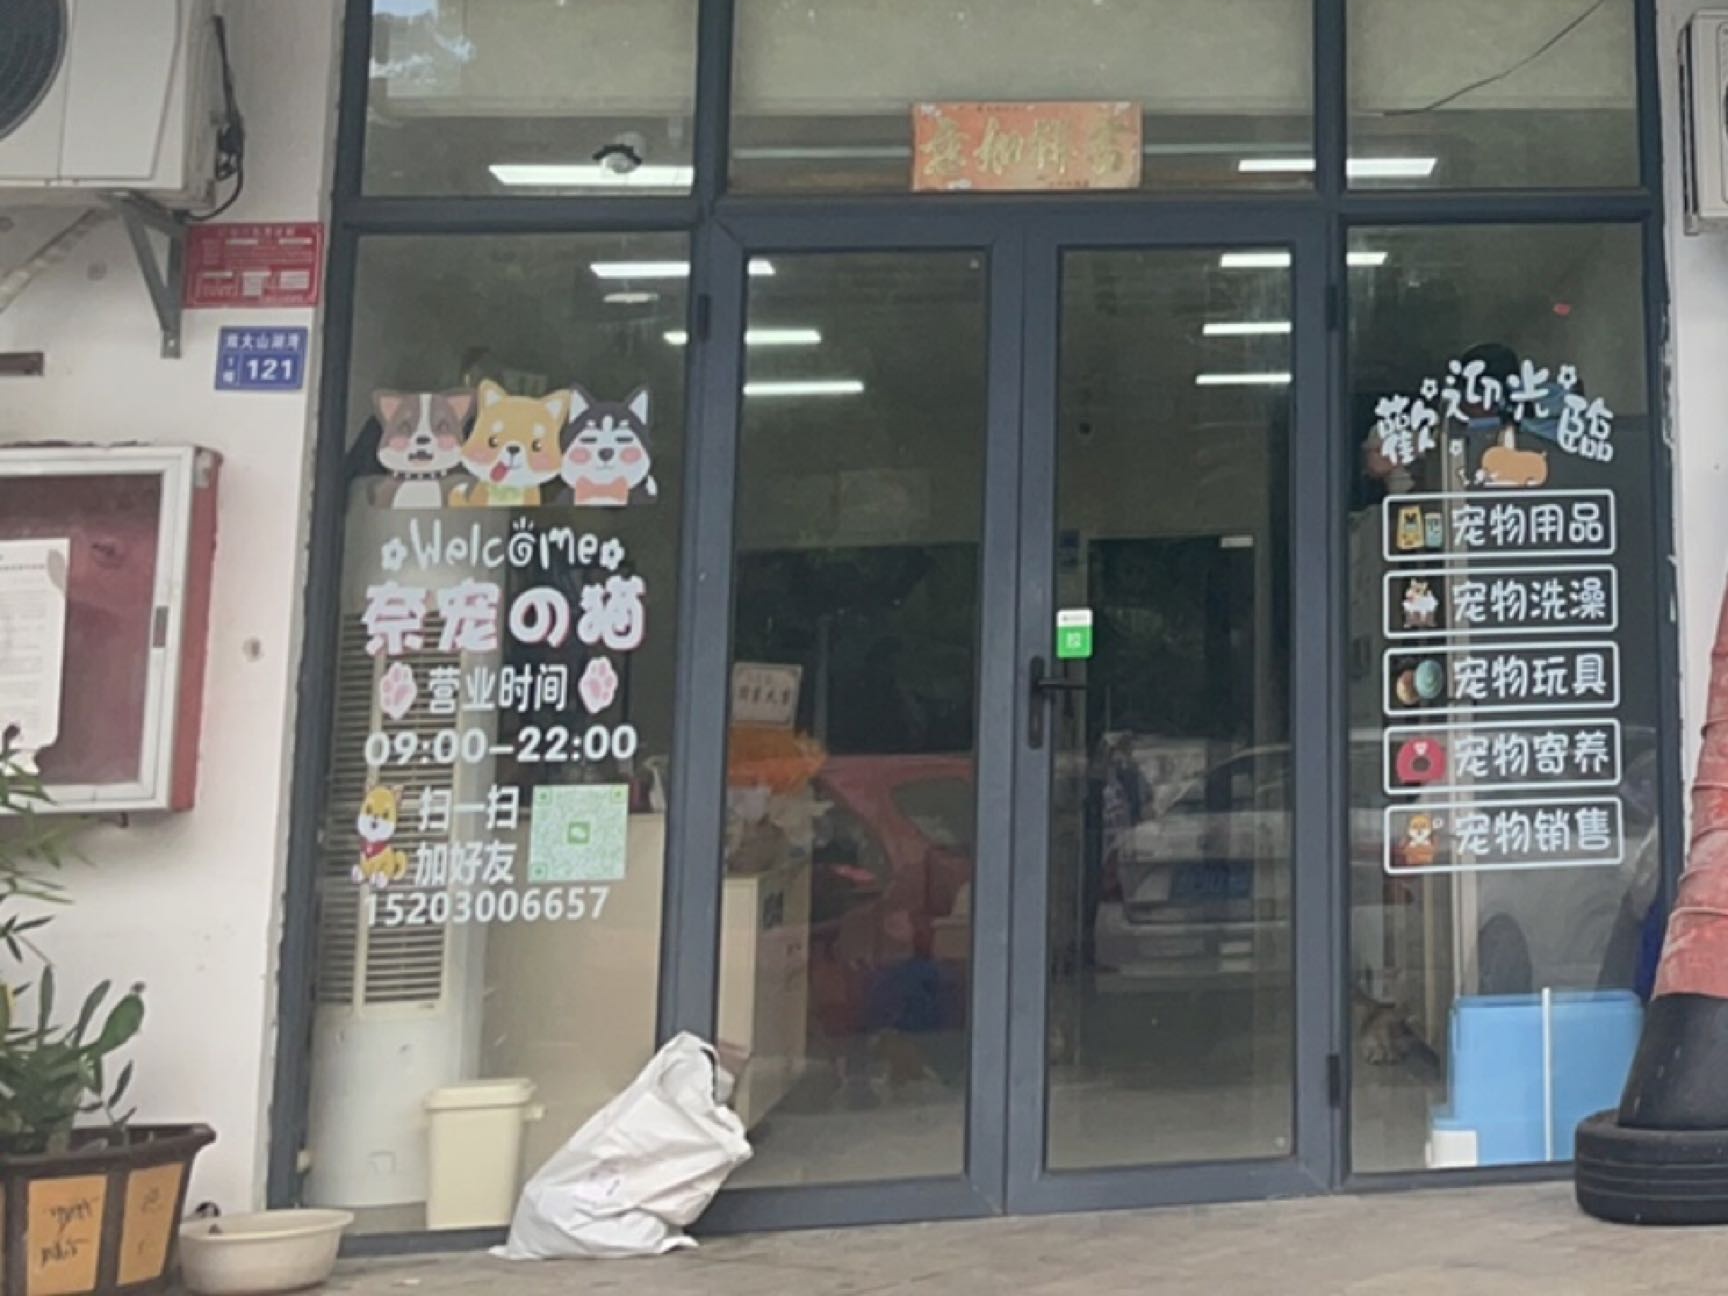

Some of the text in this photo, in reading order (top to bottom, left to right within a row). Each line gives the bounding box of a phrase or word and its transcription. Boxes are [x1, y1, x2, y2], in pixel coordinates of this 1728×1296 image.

[245, 358, 293, 382] 121
[1452, 502, 1605, 548] 宠物用品
[362, 574, 647, 656] 奈宠の猫
[1453, 577, 1607, 623] 宠物洗澡
[428, 662, 569, 713] 营业时间
[1453, 654, 1608, 700] 宠物玩具
[1454, 730, 1609, 777] 宠物寄养
[417, 784, 520, 833] 扫一扫
[1455, 808, 1611, 857] 宠物销售
[414, 839, 517, 887] 加好友
[363, 887, 609, 927] 15203006657
